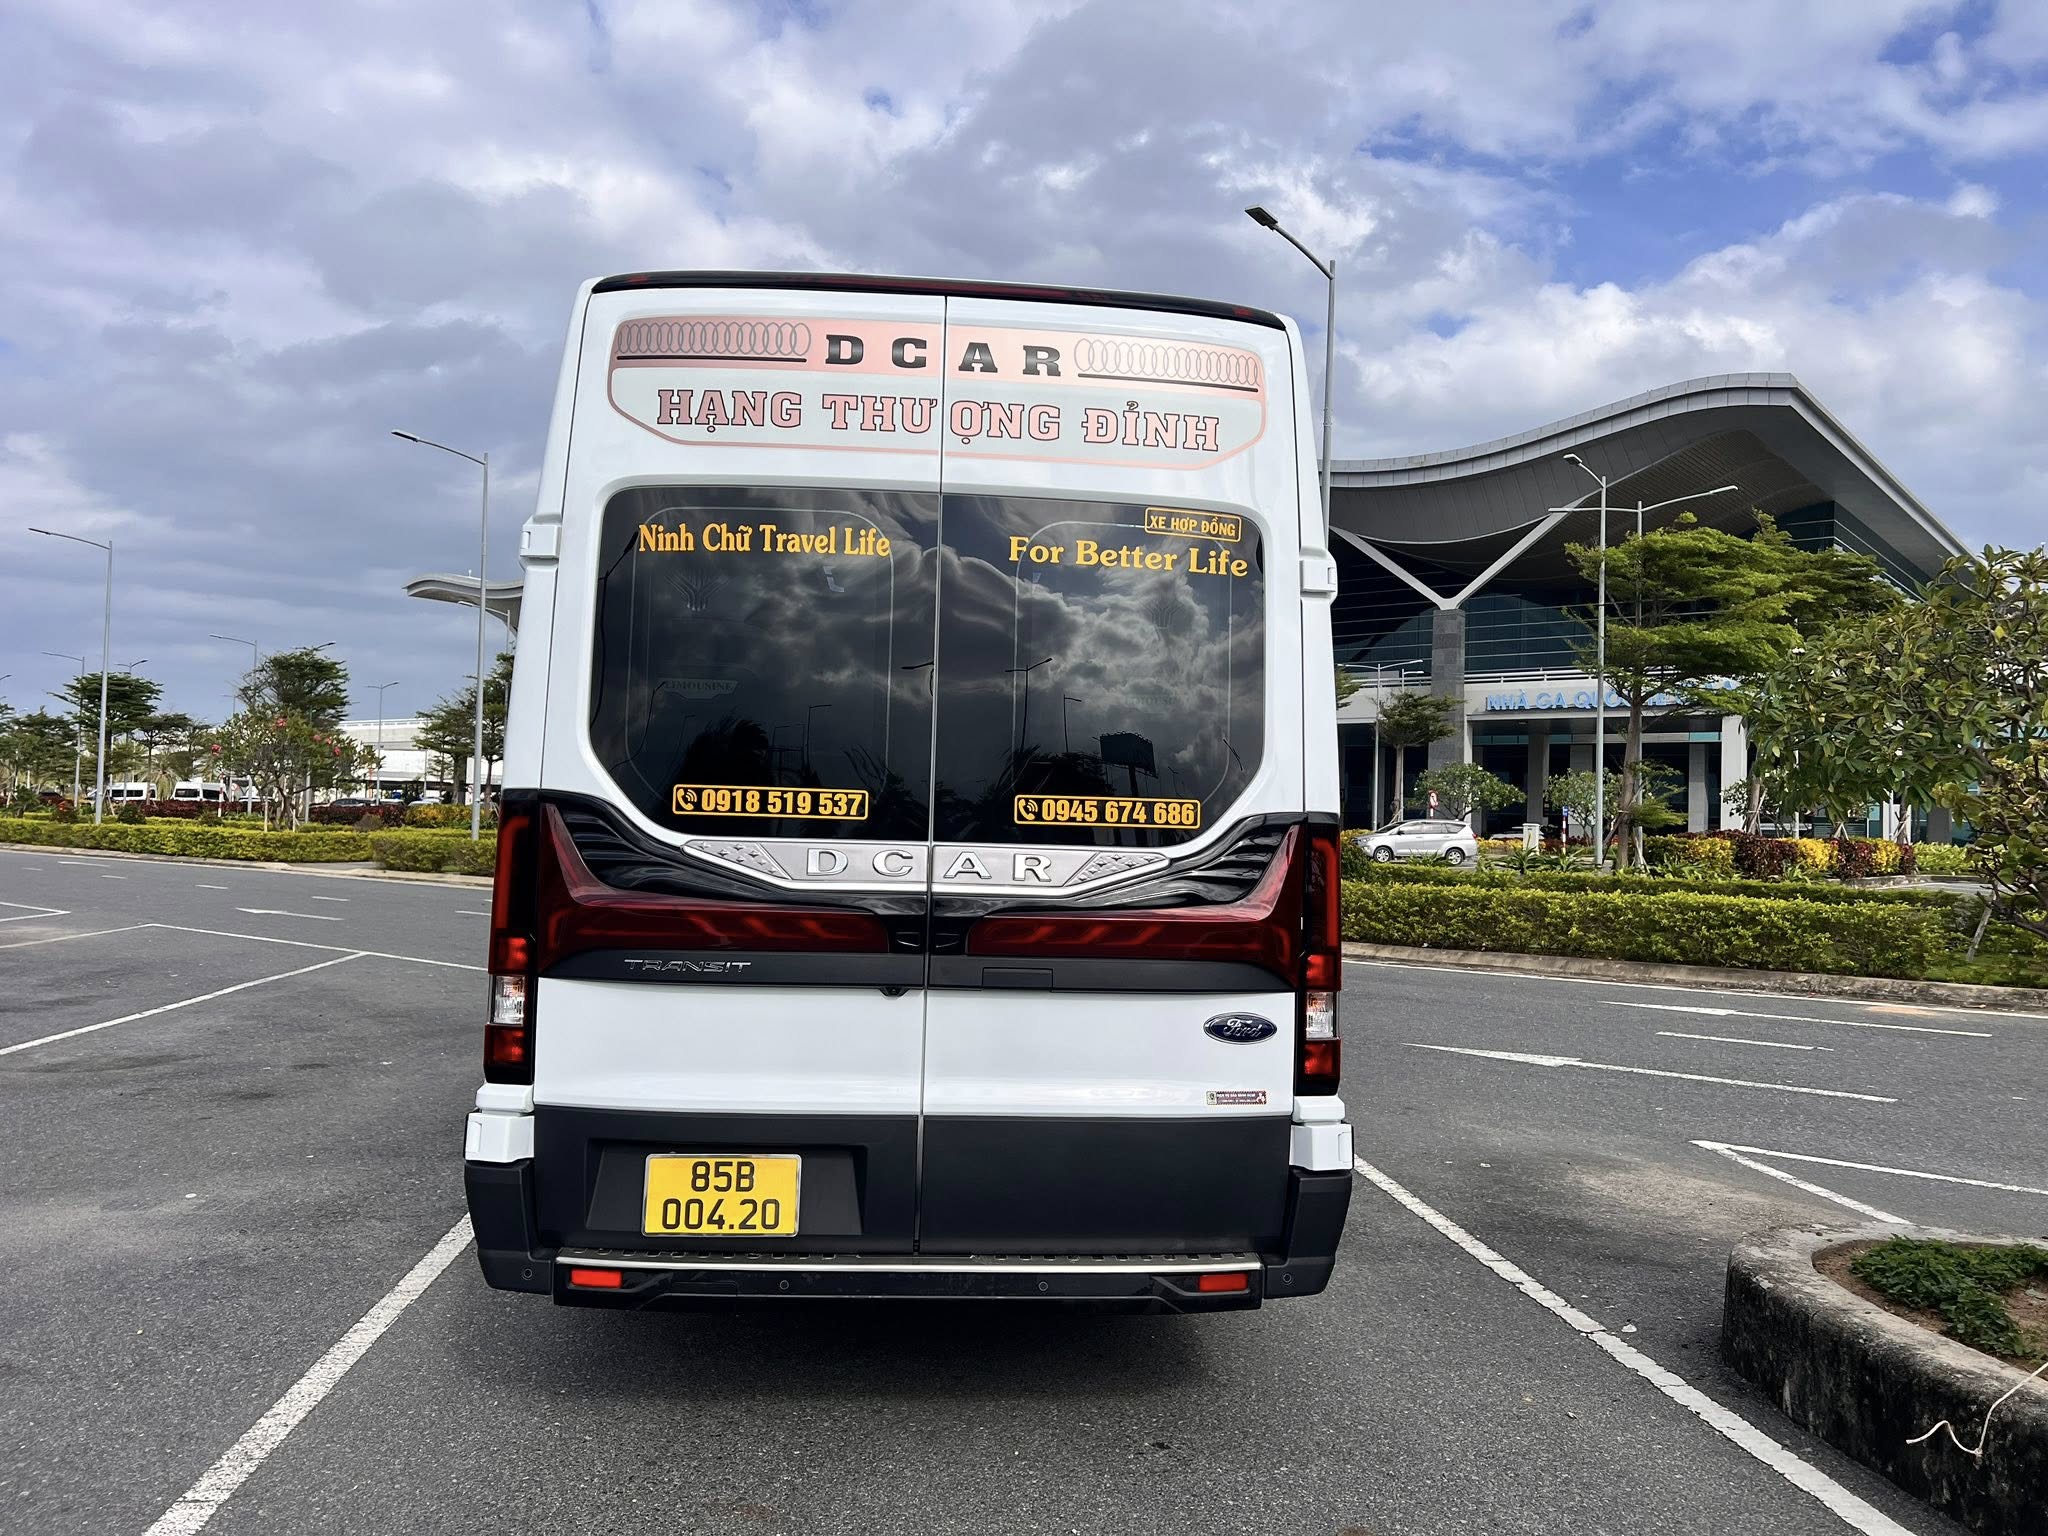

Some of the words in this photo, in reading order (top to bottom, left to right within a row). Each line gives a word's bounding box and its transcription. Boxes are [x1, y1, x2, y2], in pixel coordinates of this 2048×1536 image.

[657, 389, 802, 433] HẠNG
[821, 393, 1061, 445] THƯỢNG
[1080, 400, 1219, 452] ĐỈNH
[637, 522, 695, 552] Ninh
[702, 522, 753, 552] Chữ
[759, 524, 836, 554] Travel
[843, 526, 891, 557] Life
[1149, 515, 1167, 529] XE
[1170, 516, 1198, 534] HỢP
[1200, 516, 1236, 537] ĐỒNG
[1008, 535, 1064, 564] For
[1075, 539, 1177, 571] Better
[1187, 546, 1248, 578] Life
[1487, 688, 1530, 711] NHÀ
[1536, 692, 1568, 710] GA
[701, 788, 760, 813] 0918
[767, 790, 812, 814] 519
[818, 793, 863, 816] 537
[1041, 799, 1098, 822] 0945
[1104, 801, 1146, 823] 674
[1153, 803, 1195, 825] 686
[806, 847, 1052, 882] DCAR
[624, 959, 752, 973] TRANSIT
[1223, 1018, 1263, 1037] Ford
[691, 1161, 755, 1192] 85B
[662, 1198, 780, 1230] 004.20
